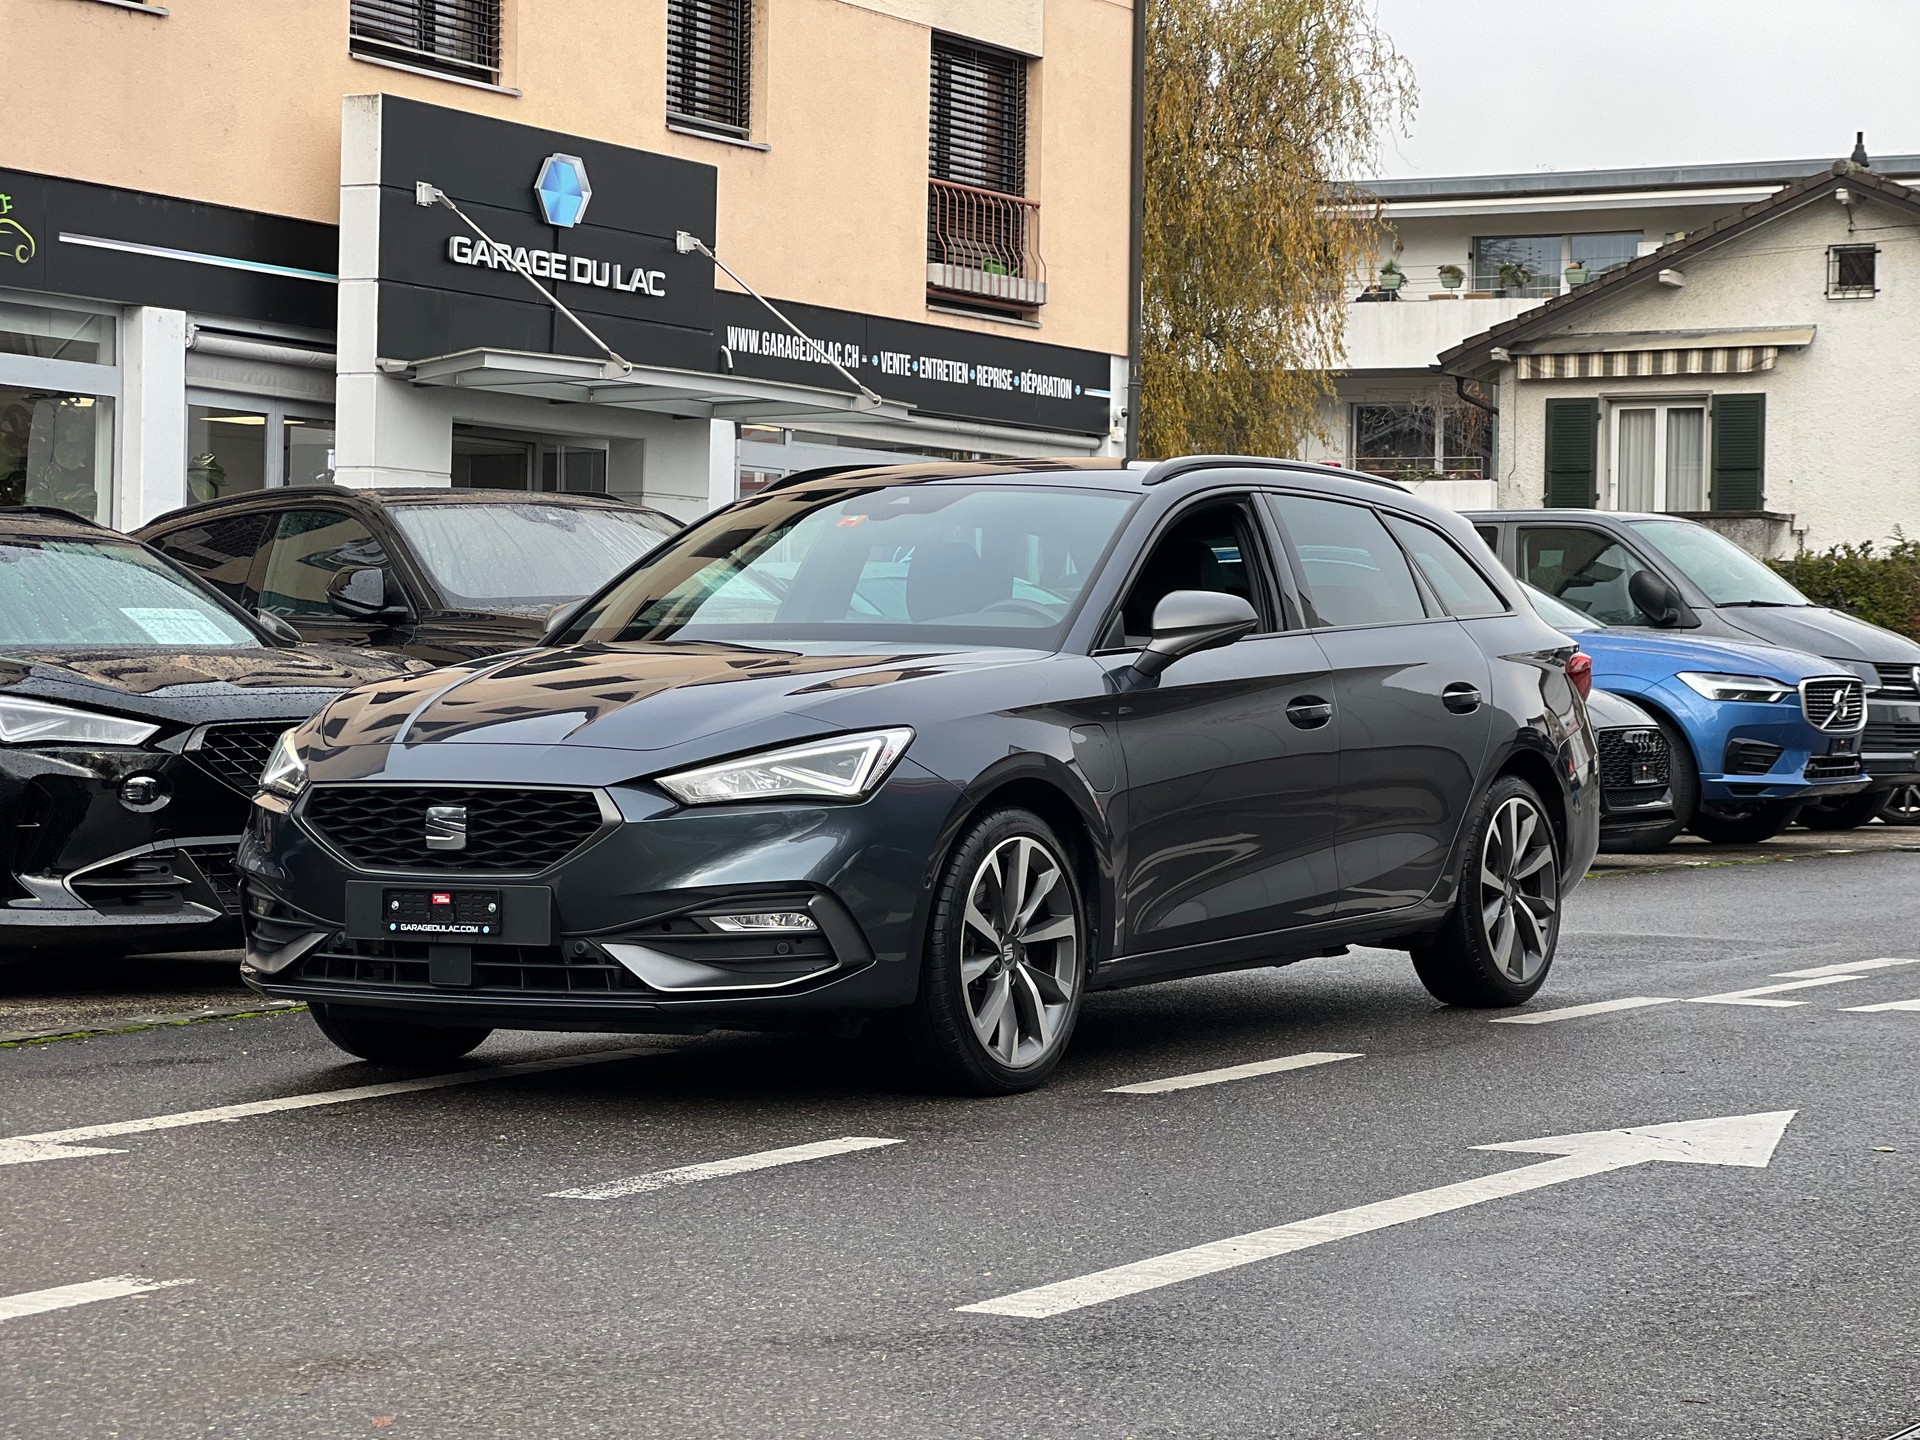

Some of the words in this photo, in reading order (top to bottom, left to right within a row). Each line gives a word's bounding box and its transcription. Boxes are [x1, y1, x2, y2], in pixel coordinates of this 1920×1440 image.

[450, 236, 567, 281] GARAGE
[570, 256, 609, 287] DU
[613, 264, 666, 297] LAC
[727, 325, 860, 368] WWW.GARAGEDULAC.CH
[880, 350, 911, 376] VENTE
[919, 356, 969, 384] ENTRETIEN
[976, 364, 1013, 391] REPRISE
[1020, 369, 1072, 399] RÉPARATION
[400, 923, 478, 933] GARAGEDULAC.COM
